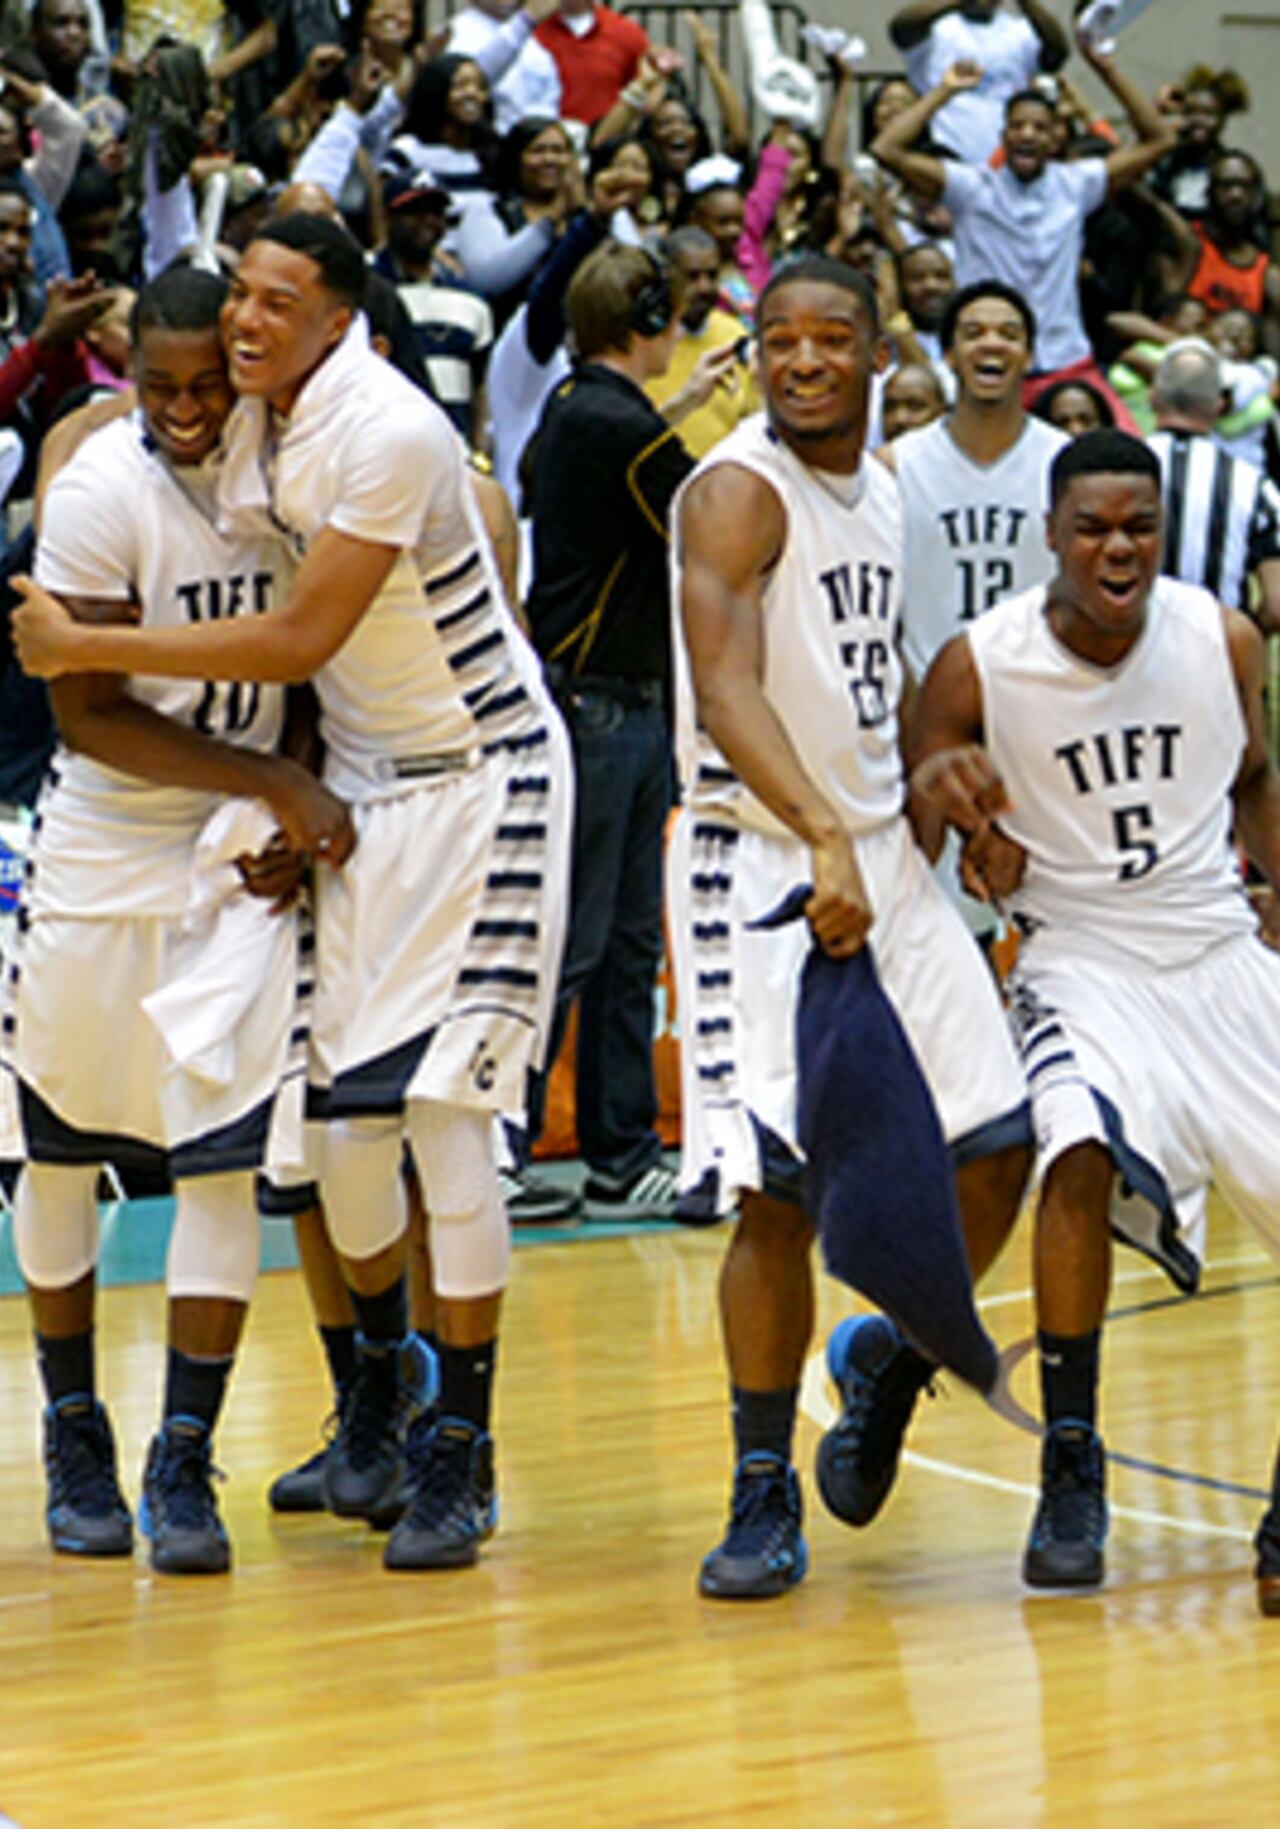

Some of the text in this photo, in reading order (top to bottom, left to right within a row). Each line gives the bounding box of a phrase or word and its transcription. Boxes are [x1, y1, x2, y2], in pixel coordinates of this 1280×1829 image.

[938, 505, 1027, 548] TIFT
[176, 571, 273, 623] TIFT
[818, 562, 894, 624] TIFT
[955, 558, 1014, 622] 12
[1054, 724, 1182, 794] TIFT
[1111, 803, 1159, 881] 5
